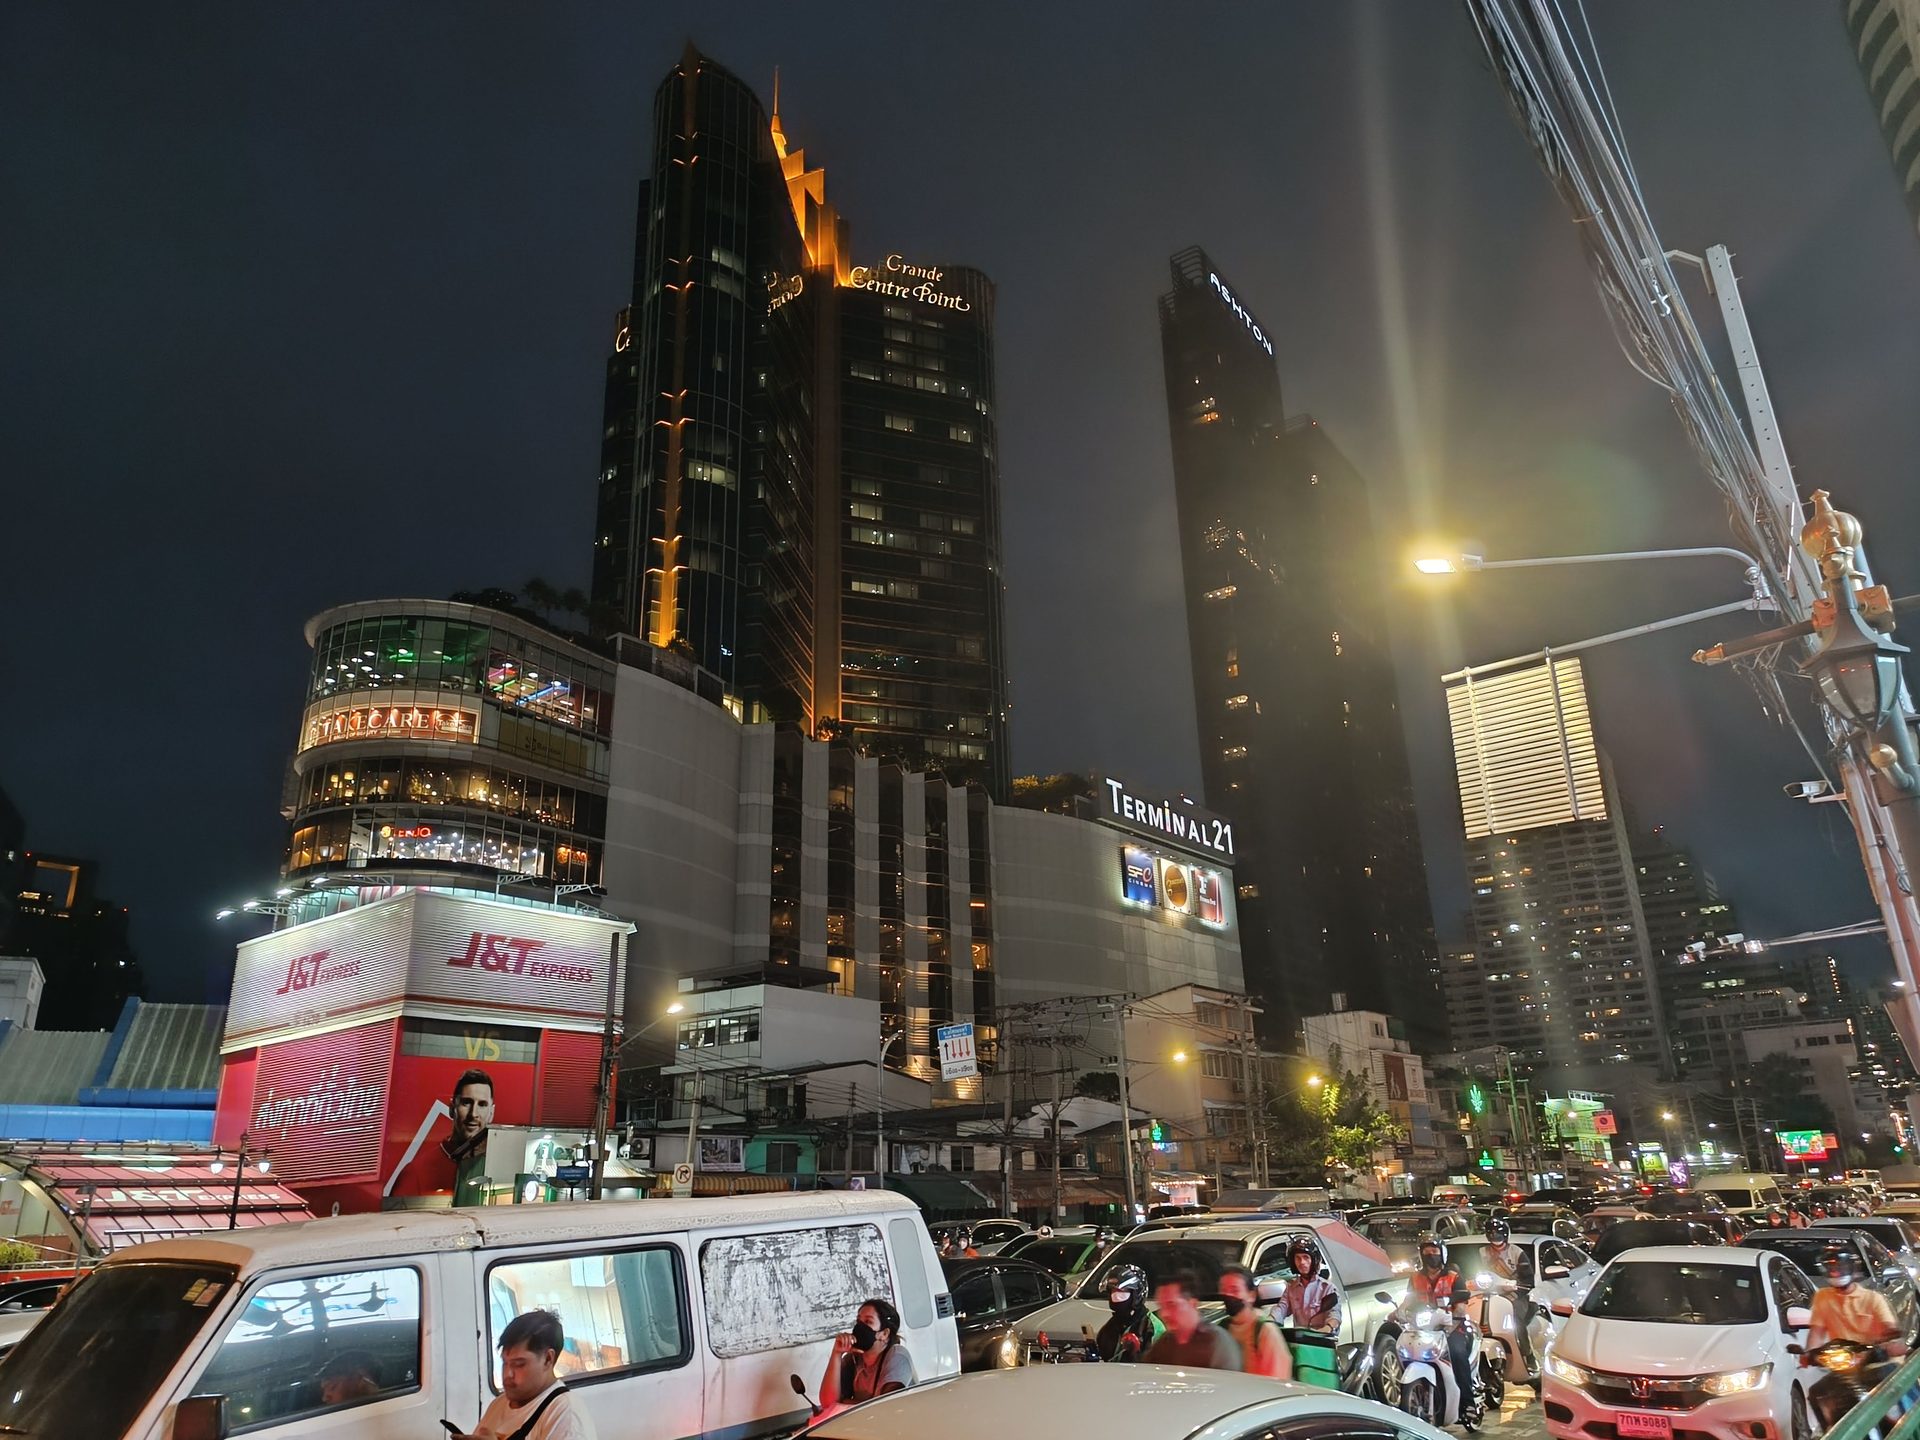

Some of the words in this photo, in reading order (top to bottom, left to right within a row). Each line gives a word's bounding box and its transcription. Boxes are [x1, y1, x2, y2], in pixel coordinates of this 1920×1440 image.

[886, 254, 944, 282] Grande
[850, 266, 910, 299] Centre
[912, 282, 971, 312] Point
[1210, 272, 1273, 355] ASHTON
[322, 713, 430, 738] TAKECARE
[1105, 777, 1212, 847] TERMINAL
[1212, 820, 1234, 855] 21
[276, 949, 333, 995] J&T
[319, 959, 362, 985] EXPRESS
[447, 931, 546, 975] J&T
[530, 961, 594, 984] EXPRESS
[464, 1029, 501, 1061] VS
[94, 1190, 204, 1202] J&T
[1641, 1416, 1667, 1429] 9088
